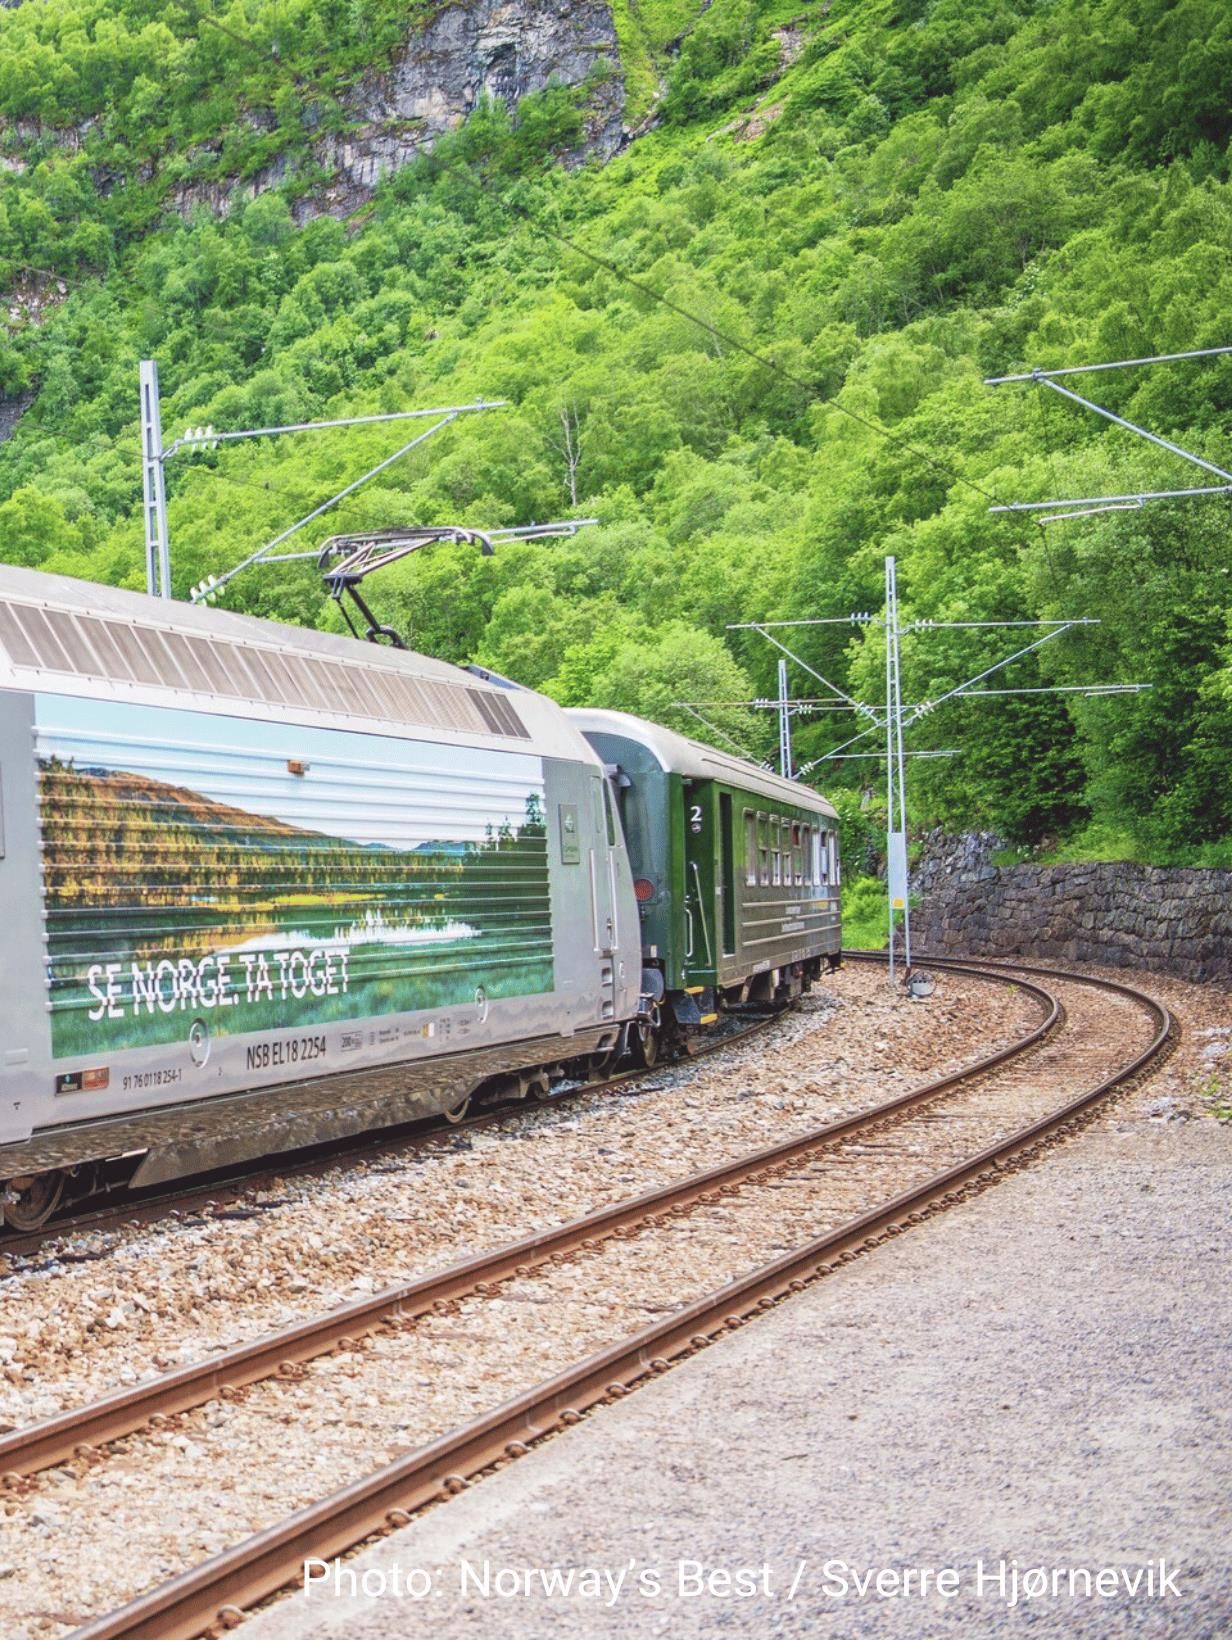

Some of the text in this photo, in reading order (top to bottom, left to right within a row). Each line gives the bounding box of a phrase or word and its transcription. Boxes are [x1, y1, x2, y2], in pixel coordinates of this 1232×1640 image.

[690, 805, 702, 822] 2
[87, 963, 125, 1021] SE
[239, 953, 273, 1003] TA
[273, 947, 350, 1001] TOGET
[247, 1043, 270, 1070] NSB
[301, 1035, 326, 1061] 2254
